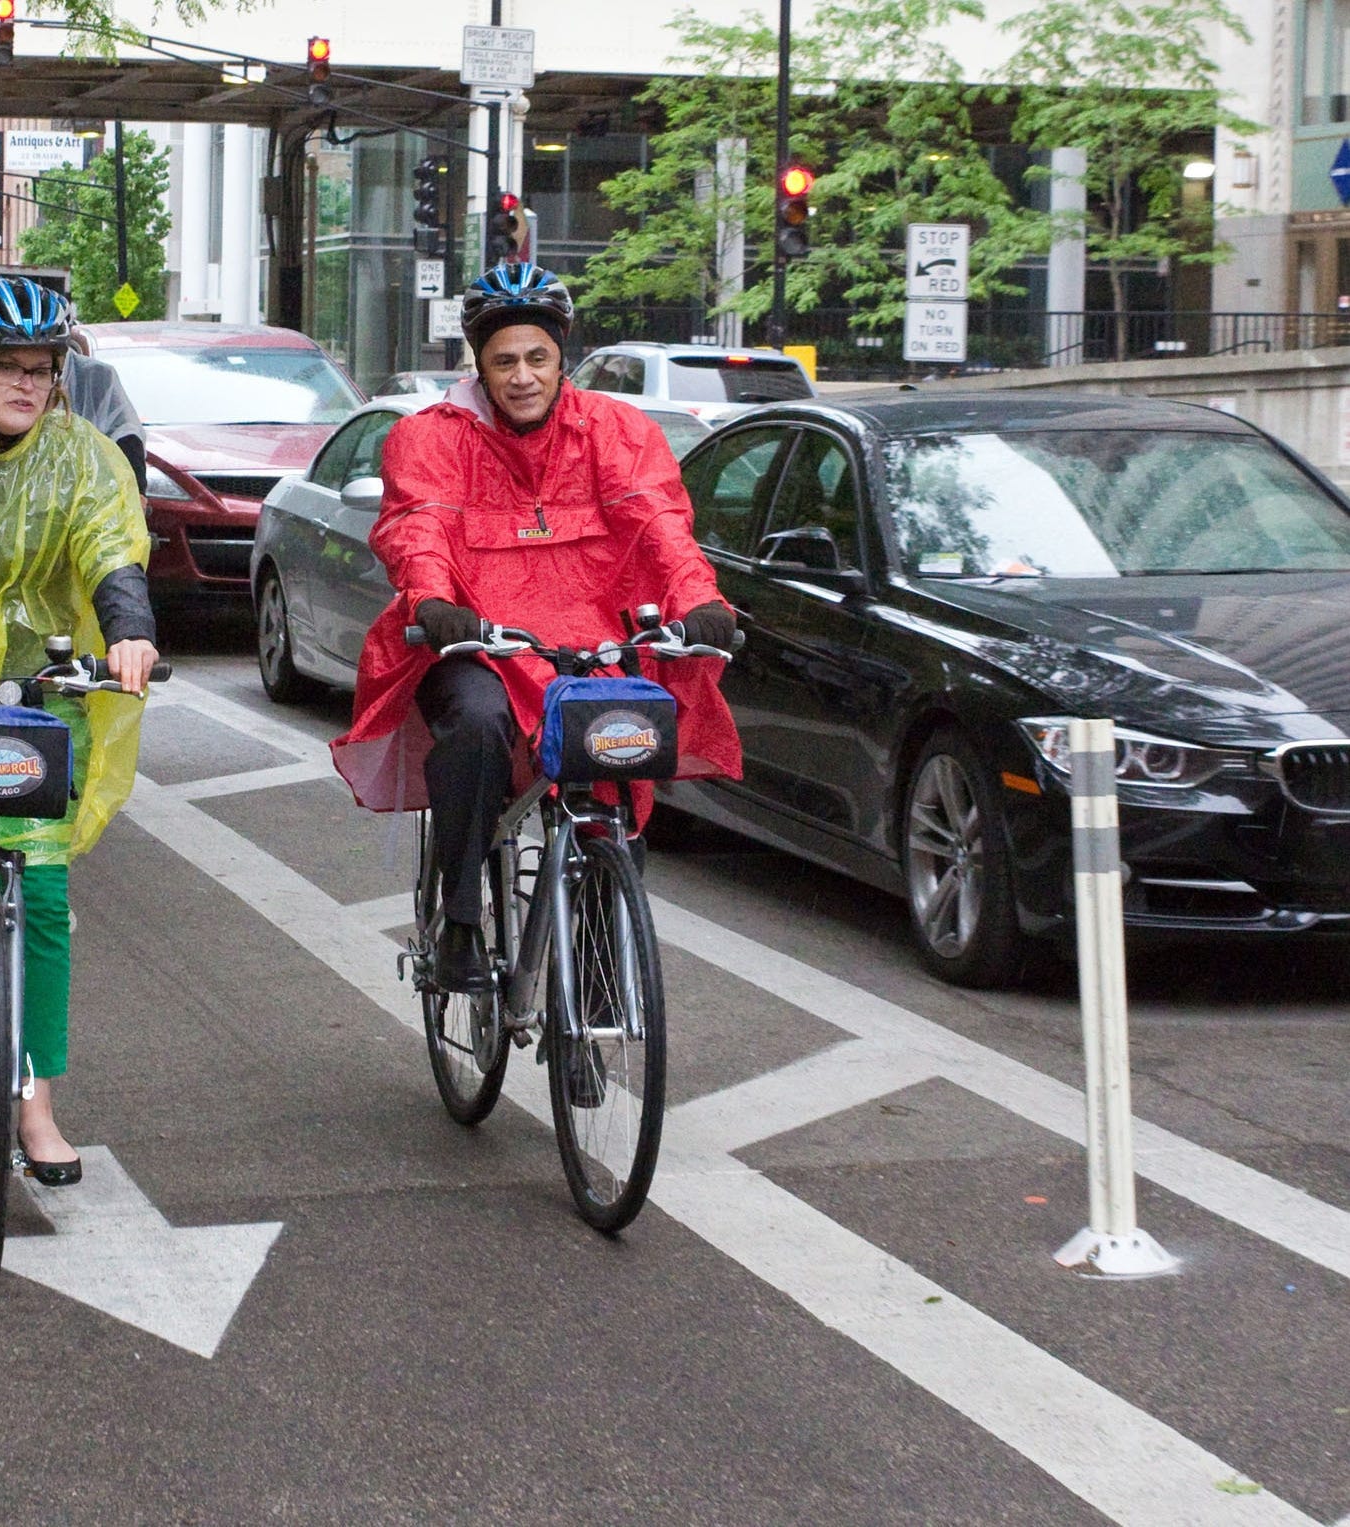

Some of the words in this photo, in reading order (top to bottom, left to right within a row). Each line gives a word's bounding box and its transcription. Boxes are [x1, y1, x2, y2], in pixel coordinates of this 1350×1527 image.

[10, 135, 53, 149] Antiques
[64, 136, 80, 148] Art
[918, 231, 961, 245] STOP
[926, 247, 951, 256] HERE
[420, 263, 442, 272] ONE
[420, 274, 442, 282] WAY
[930, 279, 960, 292] RED
[925, 309, 947, 320] NO
[919, 325, 954, 336] TURN
[910, 341, 928, 352] ON
[936, 341, 960, 353] RED
[594, 736, 616, 750] BIKE
[630, 731, 655, 746] ROLL
[0, 764, 11, 774] AND
[11, 758, 41, 775] ROLL
